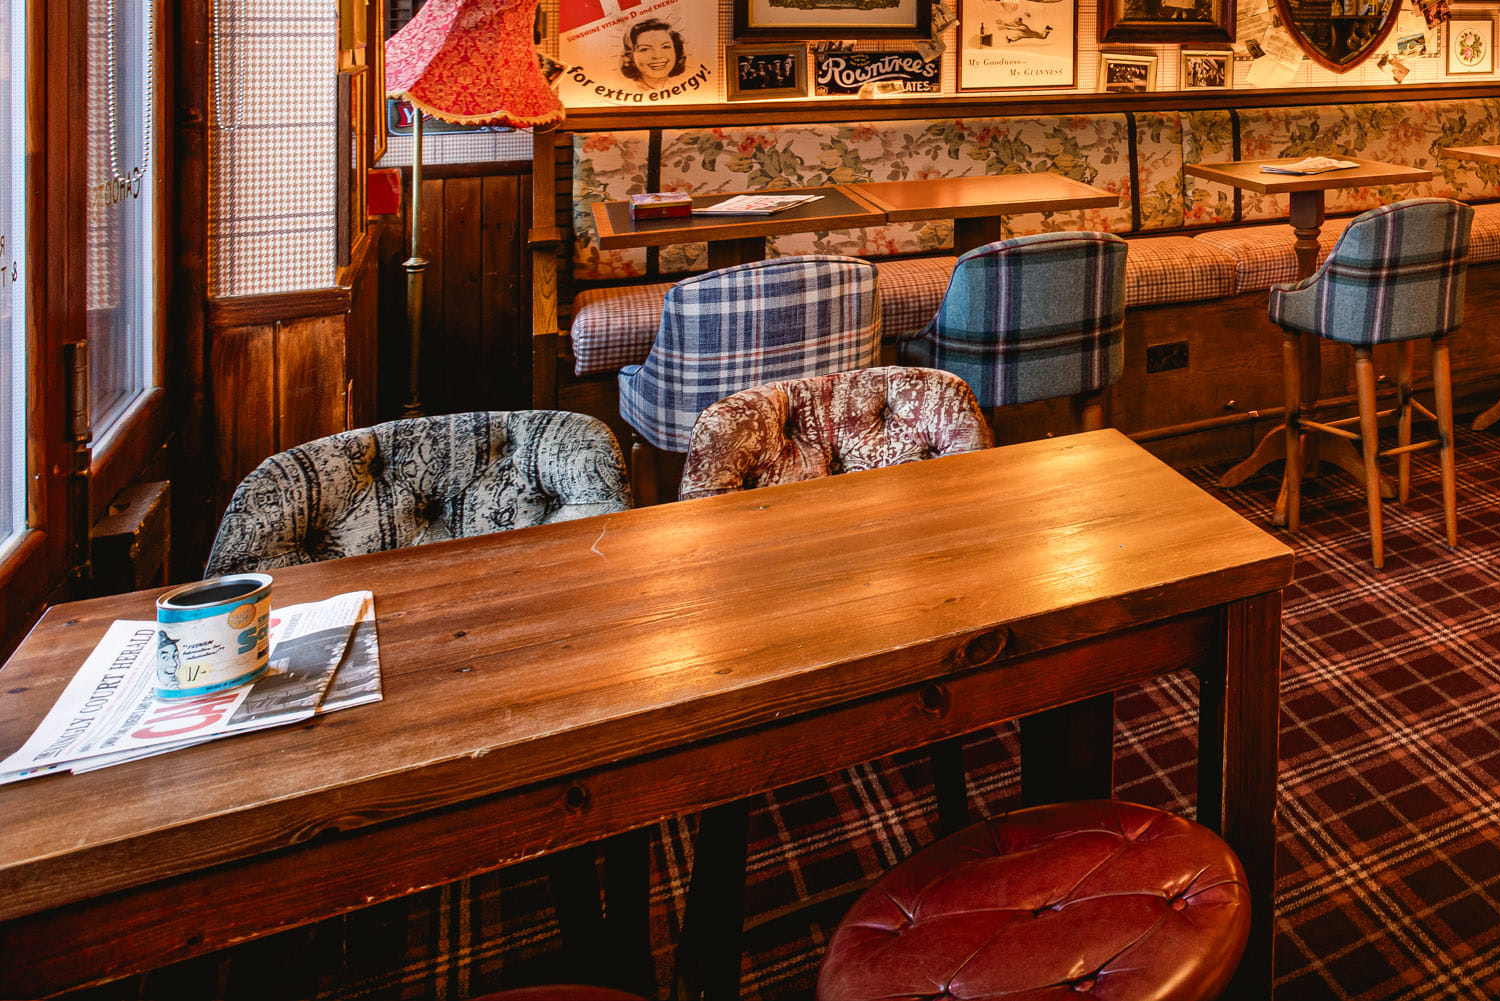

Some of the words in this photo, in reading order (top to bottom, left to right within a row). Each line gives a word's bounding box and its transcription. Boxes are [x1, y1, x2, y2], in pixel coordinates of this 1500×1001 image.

[567, 27, 601, 43] SUNSHINE
[601, 15, 630, 30] VITAMIN
[629, 10, 637, 19] D
[640, 6, 653, 16] and
[968, 58, 979, 69] My
[1010, 68, 1021, 77] My
[1024, 68, 1063, 76] GUINNESS
[567, 65, 595, 87] for
[594, 85, 643, 103] extra
[649, 63, 712, 102] energy!
[79, 673, 125, 714] COURT
[109, 628, 156, 670] HERALD
